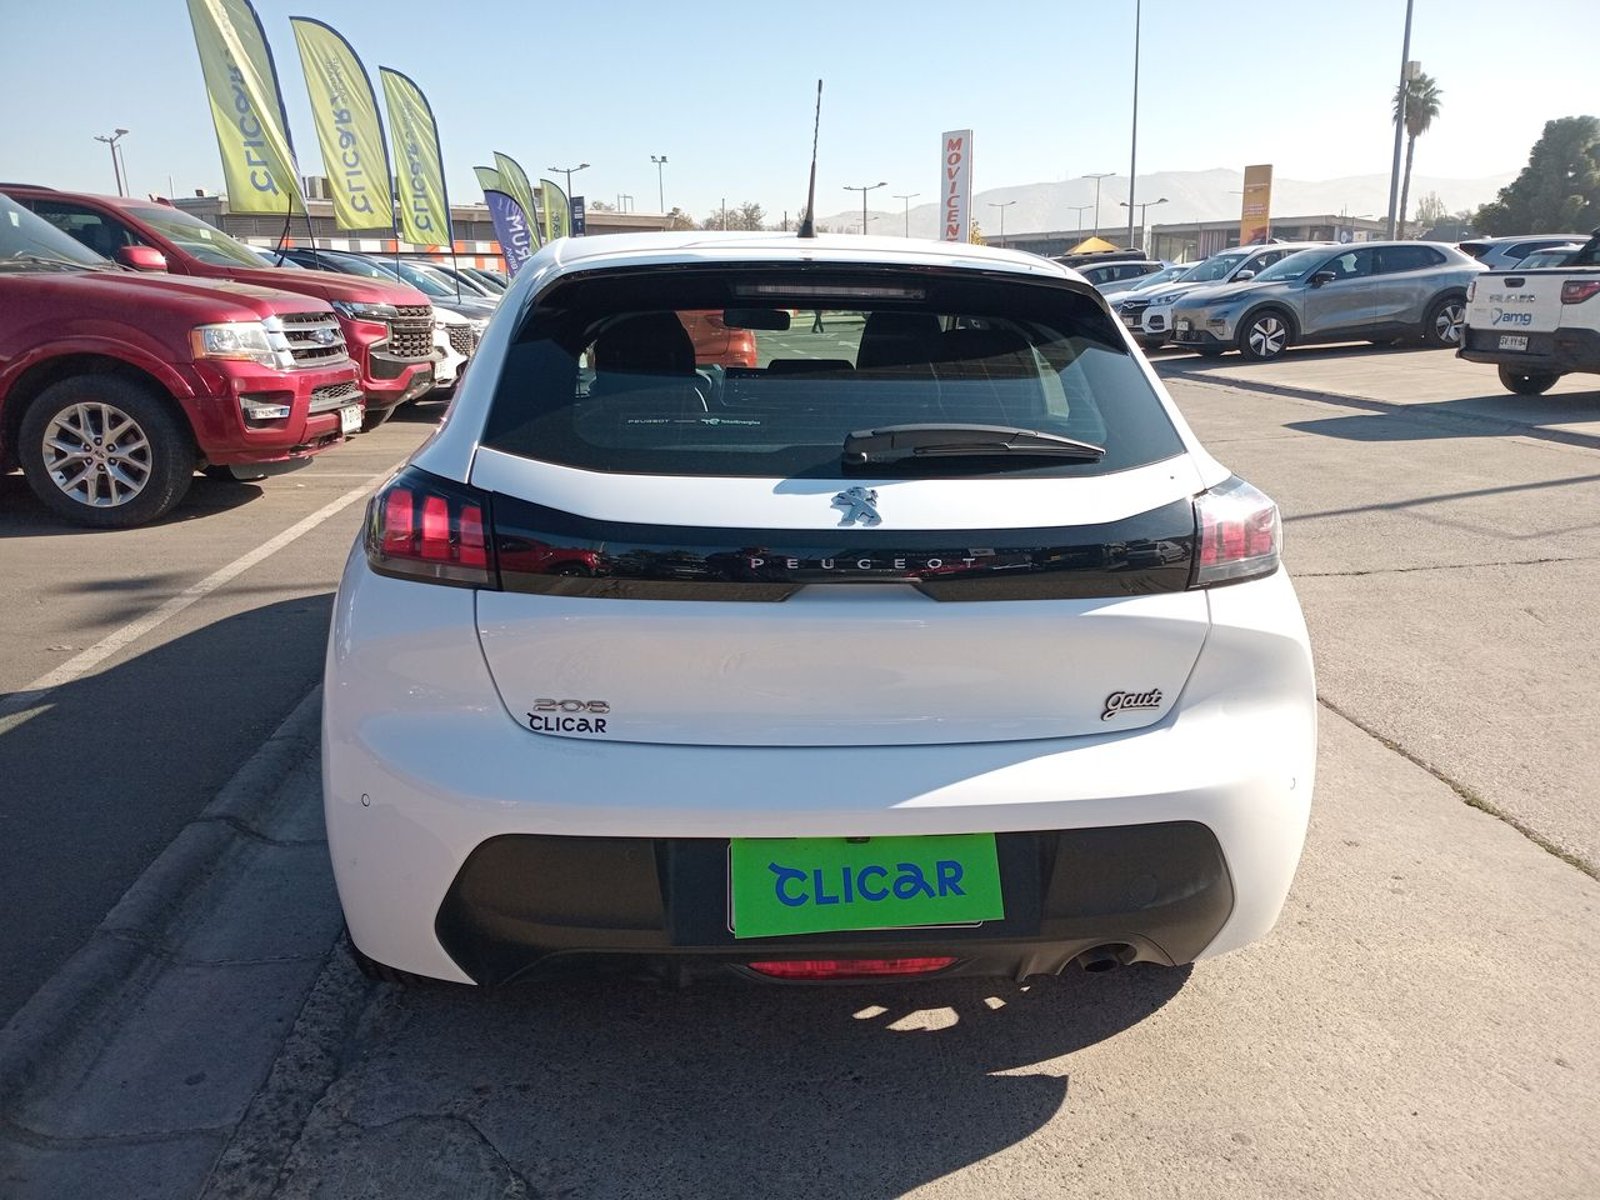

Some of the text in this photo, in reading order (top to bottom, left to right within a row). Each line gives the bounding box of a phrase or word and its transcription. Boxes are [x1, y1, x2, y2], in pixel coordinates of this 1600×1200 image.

[945, 137, 962, 241] MOVICEN
[750, 557, 976, 570] PEUGEOT
[533, 698, 611, 714] 208
